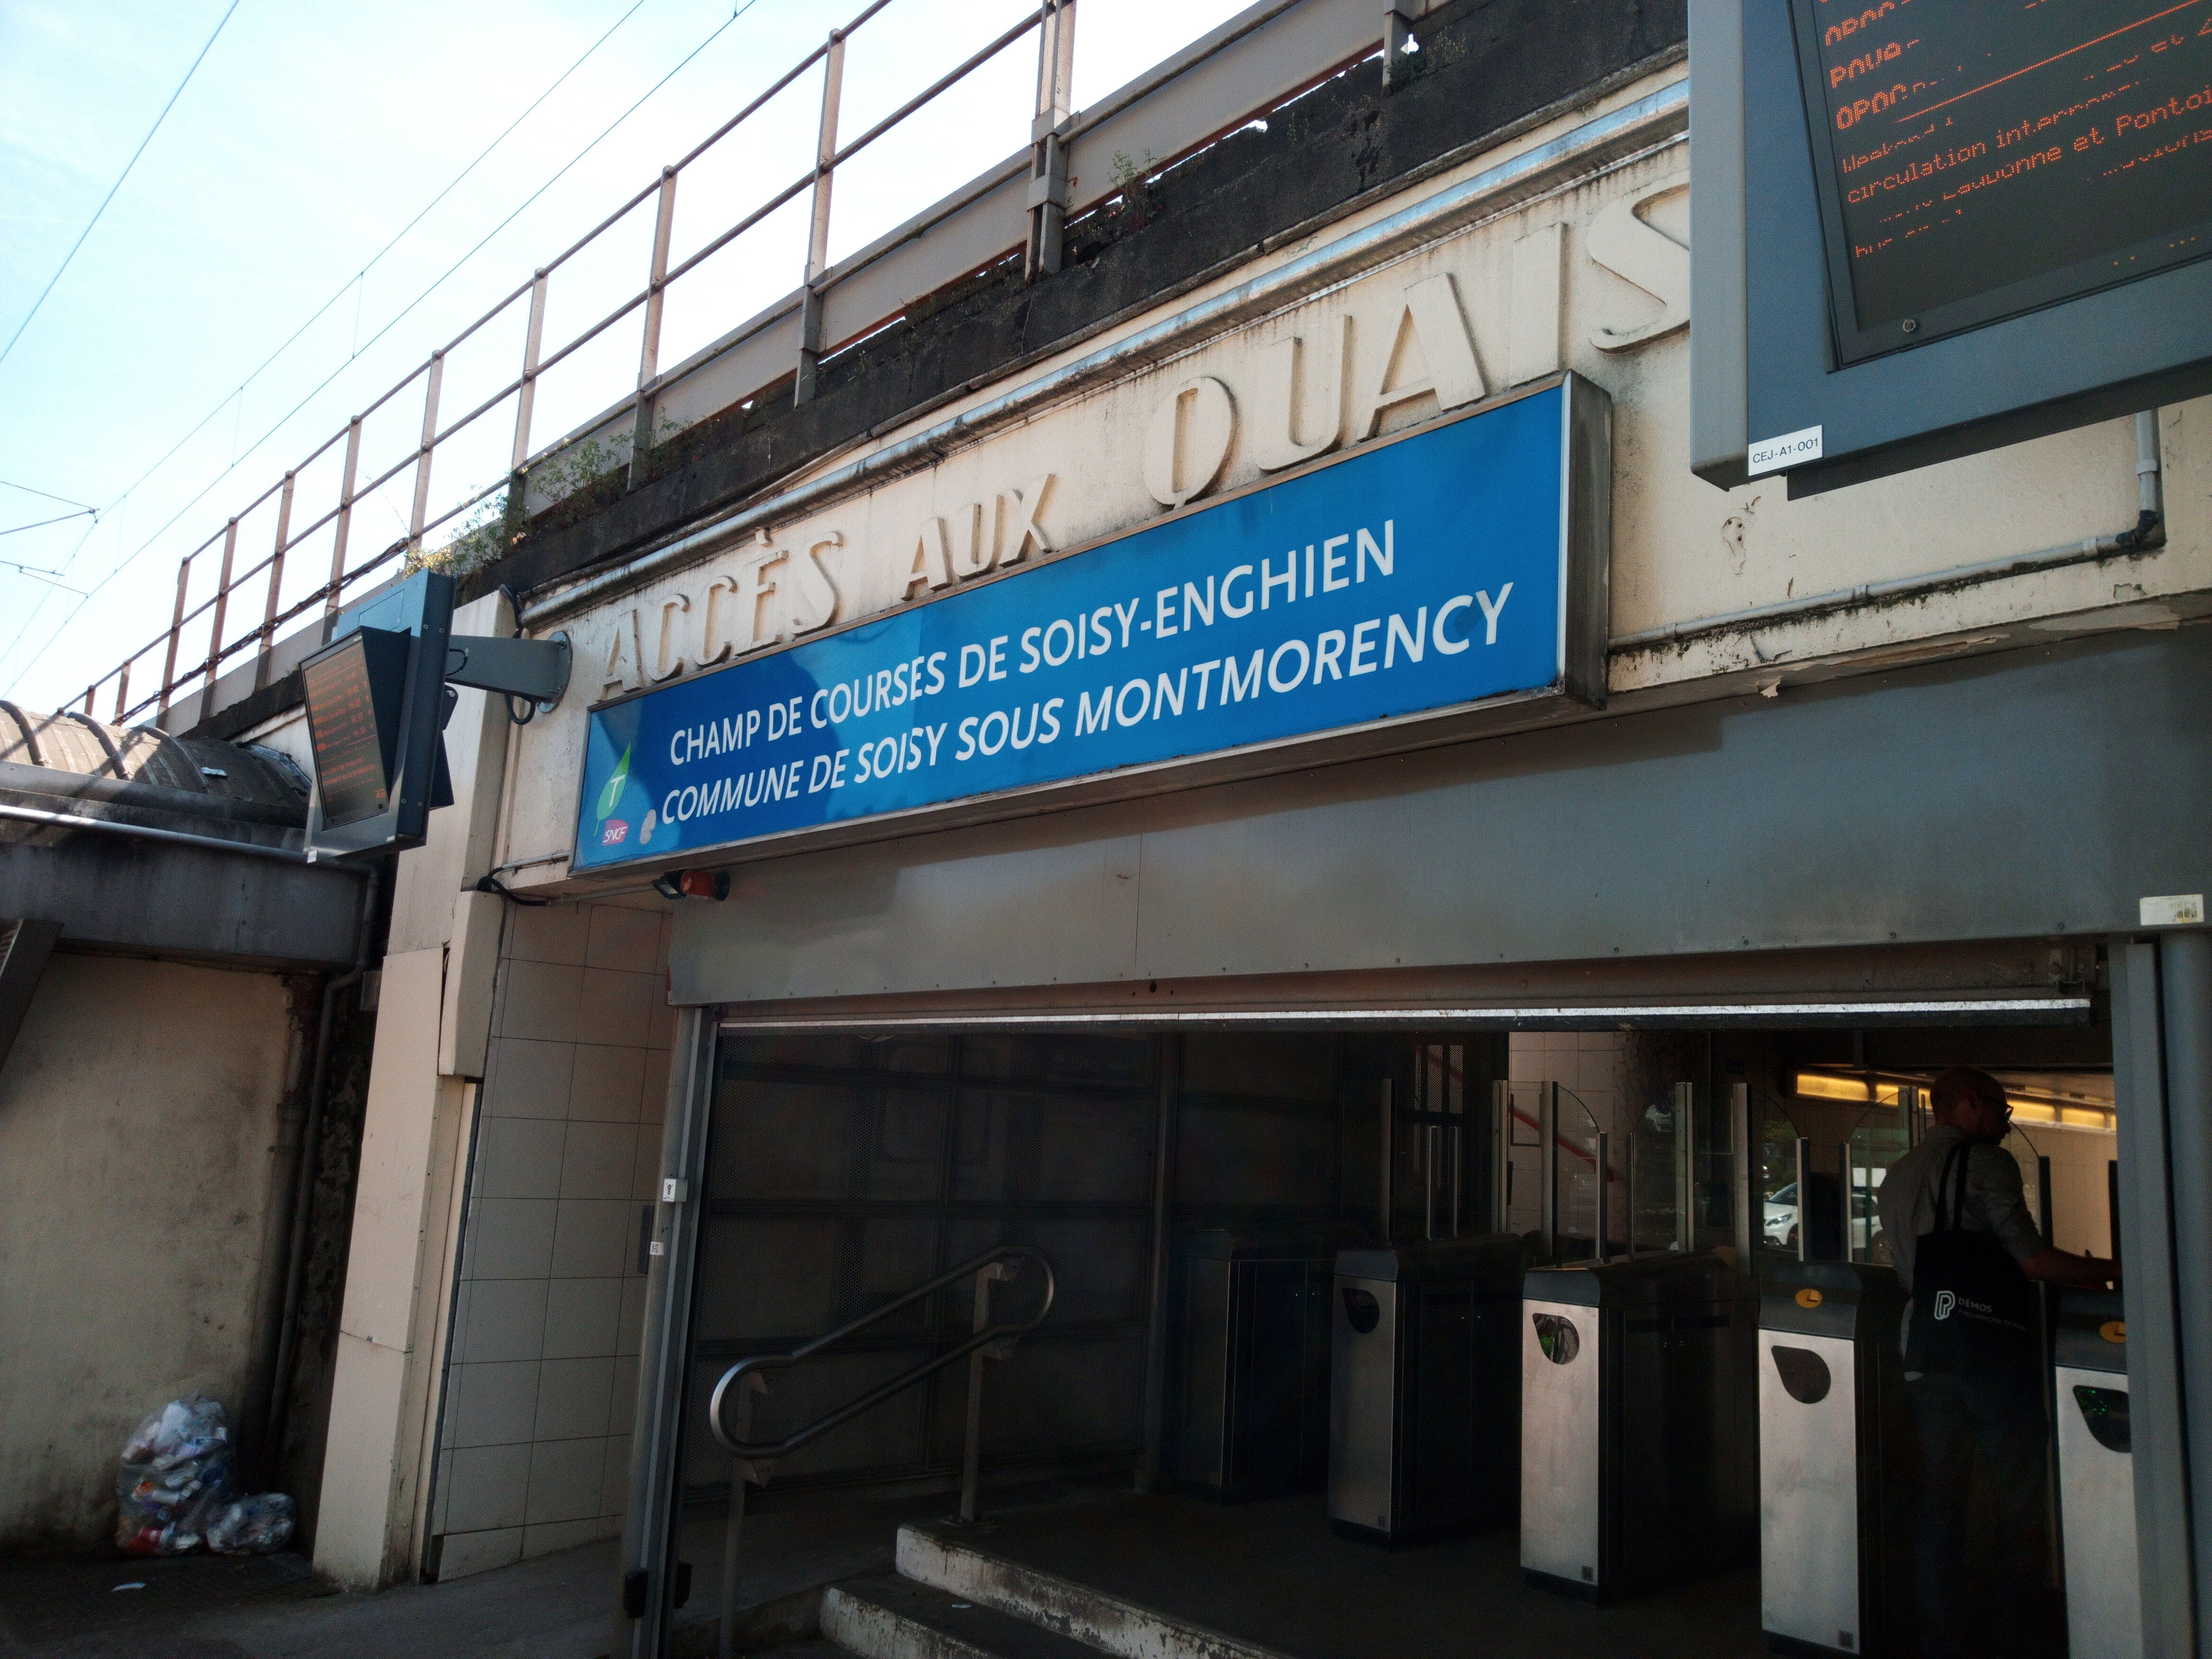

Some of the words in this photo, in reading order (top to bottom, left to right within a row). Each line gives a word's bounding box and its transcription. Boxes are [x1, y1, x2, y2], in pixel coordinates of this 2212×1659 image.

[1847, 142, 1986, 204] circulation
[2073, 127, 2105, 152] et
[597, 527, 844, 701] ACCÈS
[901, 474, 1056, 601] AUX
[671, 710, 761, 765] CHAMP
[768, 696, 803, 741] DE
[811, 651, 947, 729] COURSES
[959, 636, 1008, 688] DE
[1019, 519, 1394, 673] SOISY-ENGHIEN
[662, 760, 804, 825] COMMUNE
[808, 748, 850, 793] DE
[854, 722, 948, 784] SOISY
[956, 698, 1064, 761] SOUS
[1075, 581, 1514, 736] MONTMORENCY
[603, 826, 628, 842] SNCF
